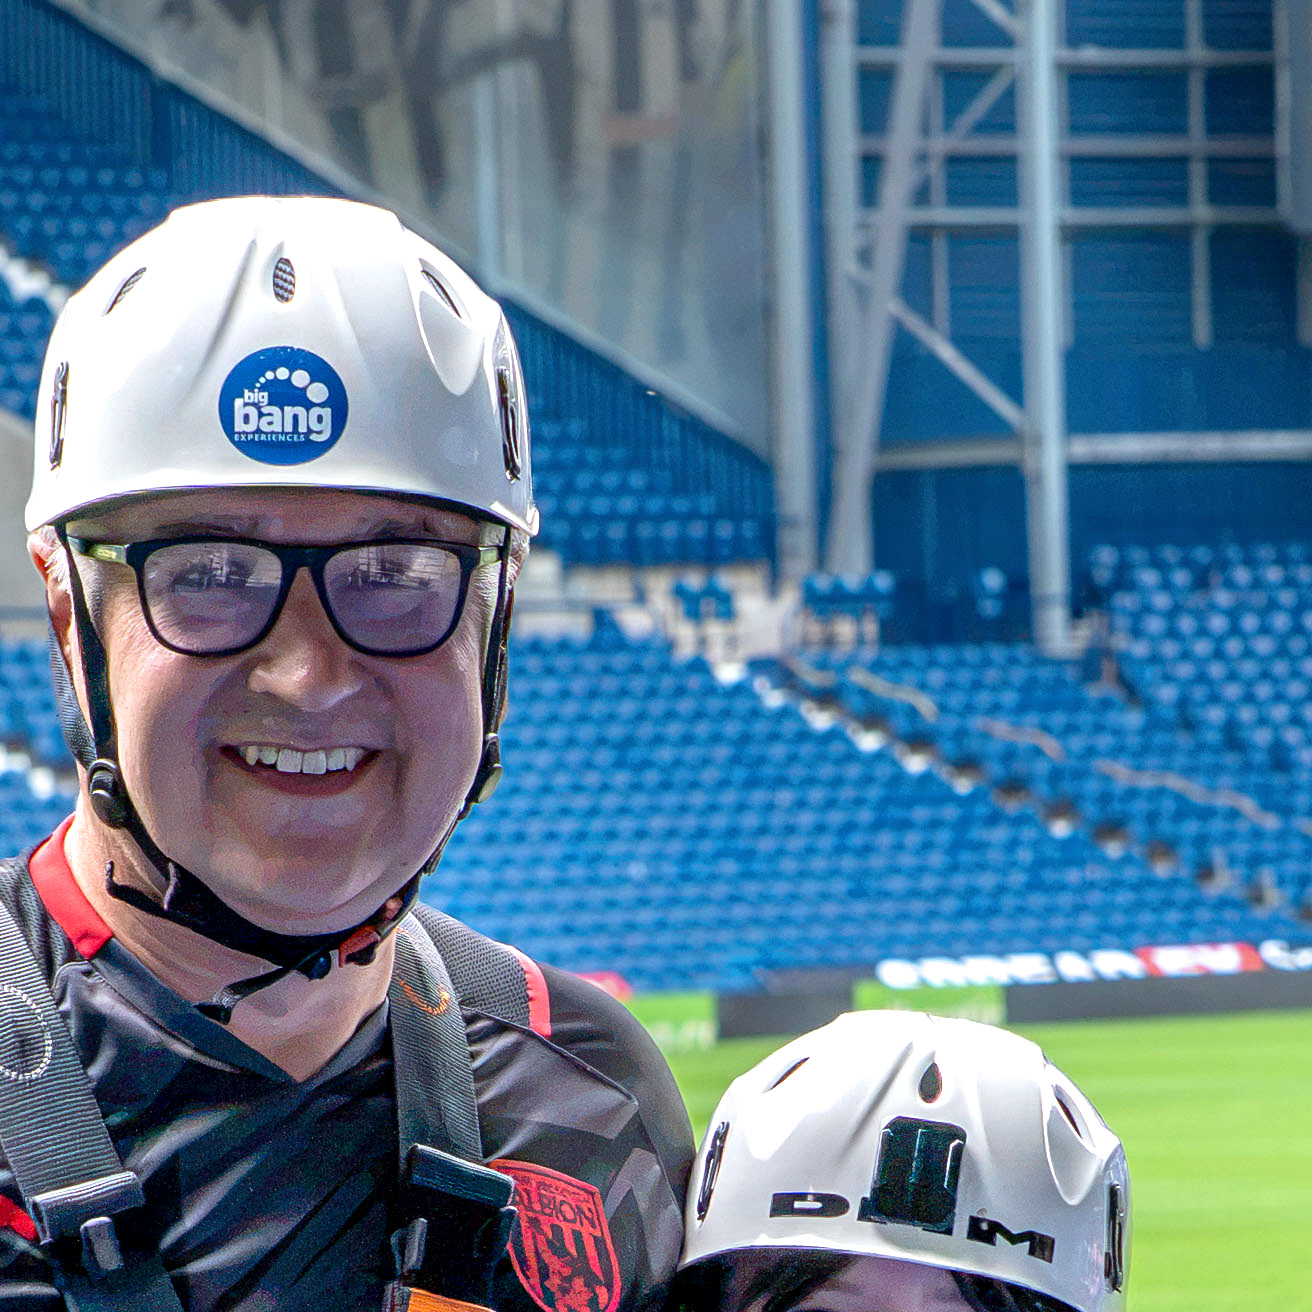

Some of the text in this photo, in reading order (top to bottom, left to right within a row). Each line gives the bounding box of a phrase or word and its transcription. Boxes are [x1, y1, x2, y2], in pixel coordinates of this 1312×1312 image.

[243, 388, 269, 406] big
[233, 397, 333, 442] bang
[233, 432, 306, 442] EXPERIENCES
